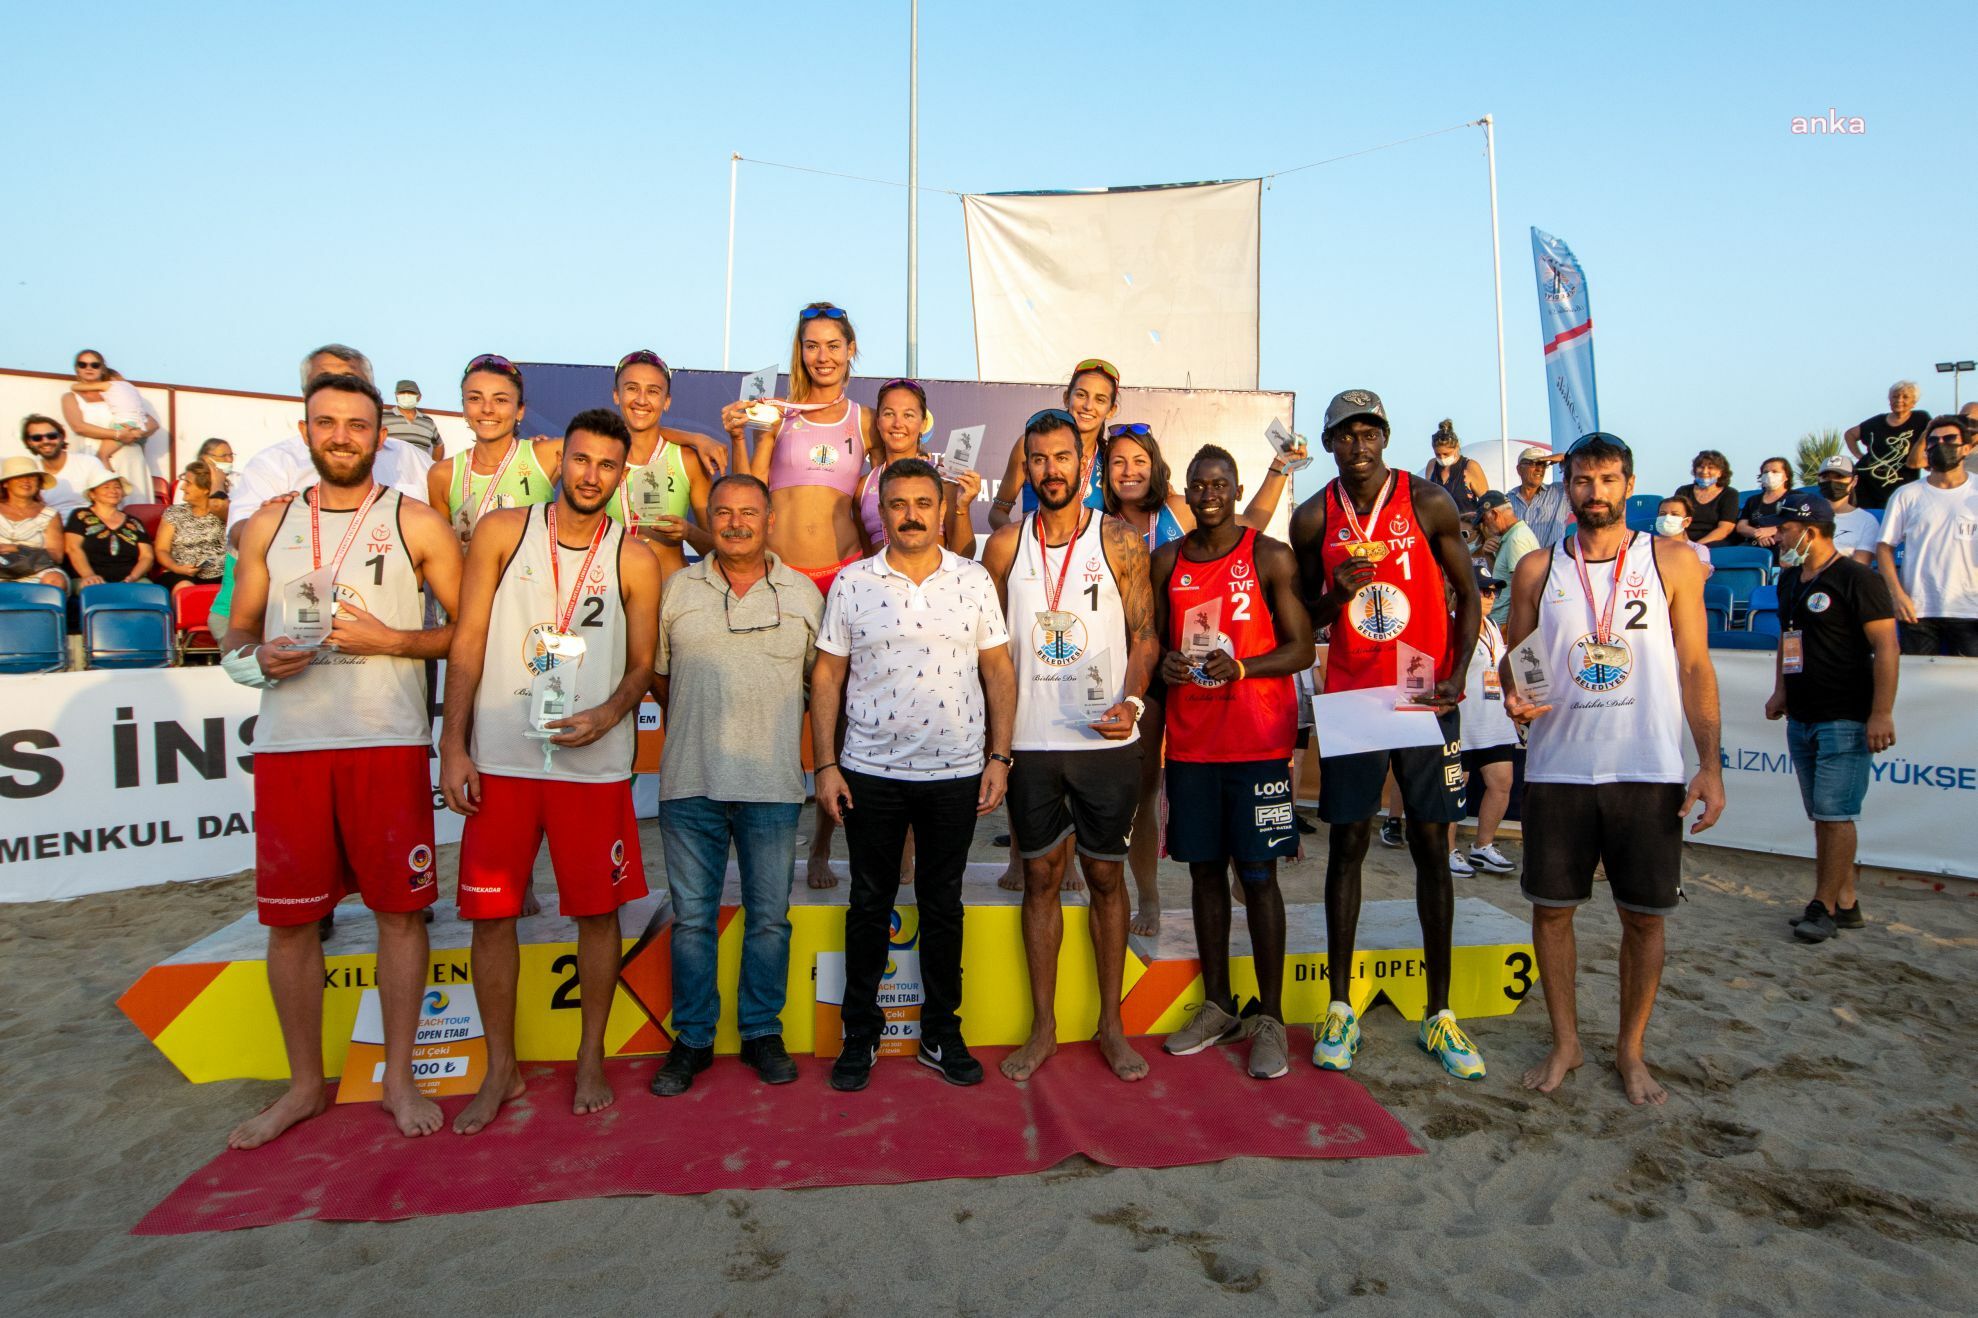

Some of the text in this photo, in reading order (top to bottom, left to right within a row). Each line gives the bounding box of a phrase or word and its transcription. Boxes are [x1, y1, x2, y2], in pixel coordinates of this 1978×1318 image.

[844, 437, 853, 455] 1
[519, 477, 530, 496] 1
[366, 543, 393, 554] TVF
[1387, 536, 1415, 550] TVF
[365, 554, 385, 586] 1
[1395, 551, 1412, 580] 1
[1083, 573, 1104, 583] TVF
[1228, 580, 1254, 592] TVF
[585, 585, 607, 595] TVF
[1083, 583, 1099, 611] 1
[1624, 589, 1648, 599] TVF
[581, 596, 605, 627] 2
[1231, 592, 1251, 621] 2
[1624, 600, 1648, 630] 2
[1871, 757, 1977, 791] YÜKŞE
[0, 820, 184, 864] MENKUL
[197, 811, 256, 840] DA
[550, 954, 581, 1010] 2
[1503, 951, 1533, 1001] 3
[417, 1028, 469, 1040] OPEN ETABI
[427, 1046, 450, 1057] Çeki
